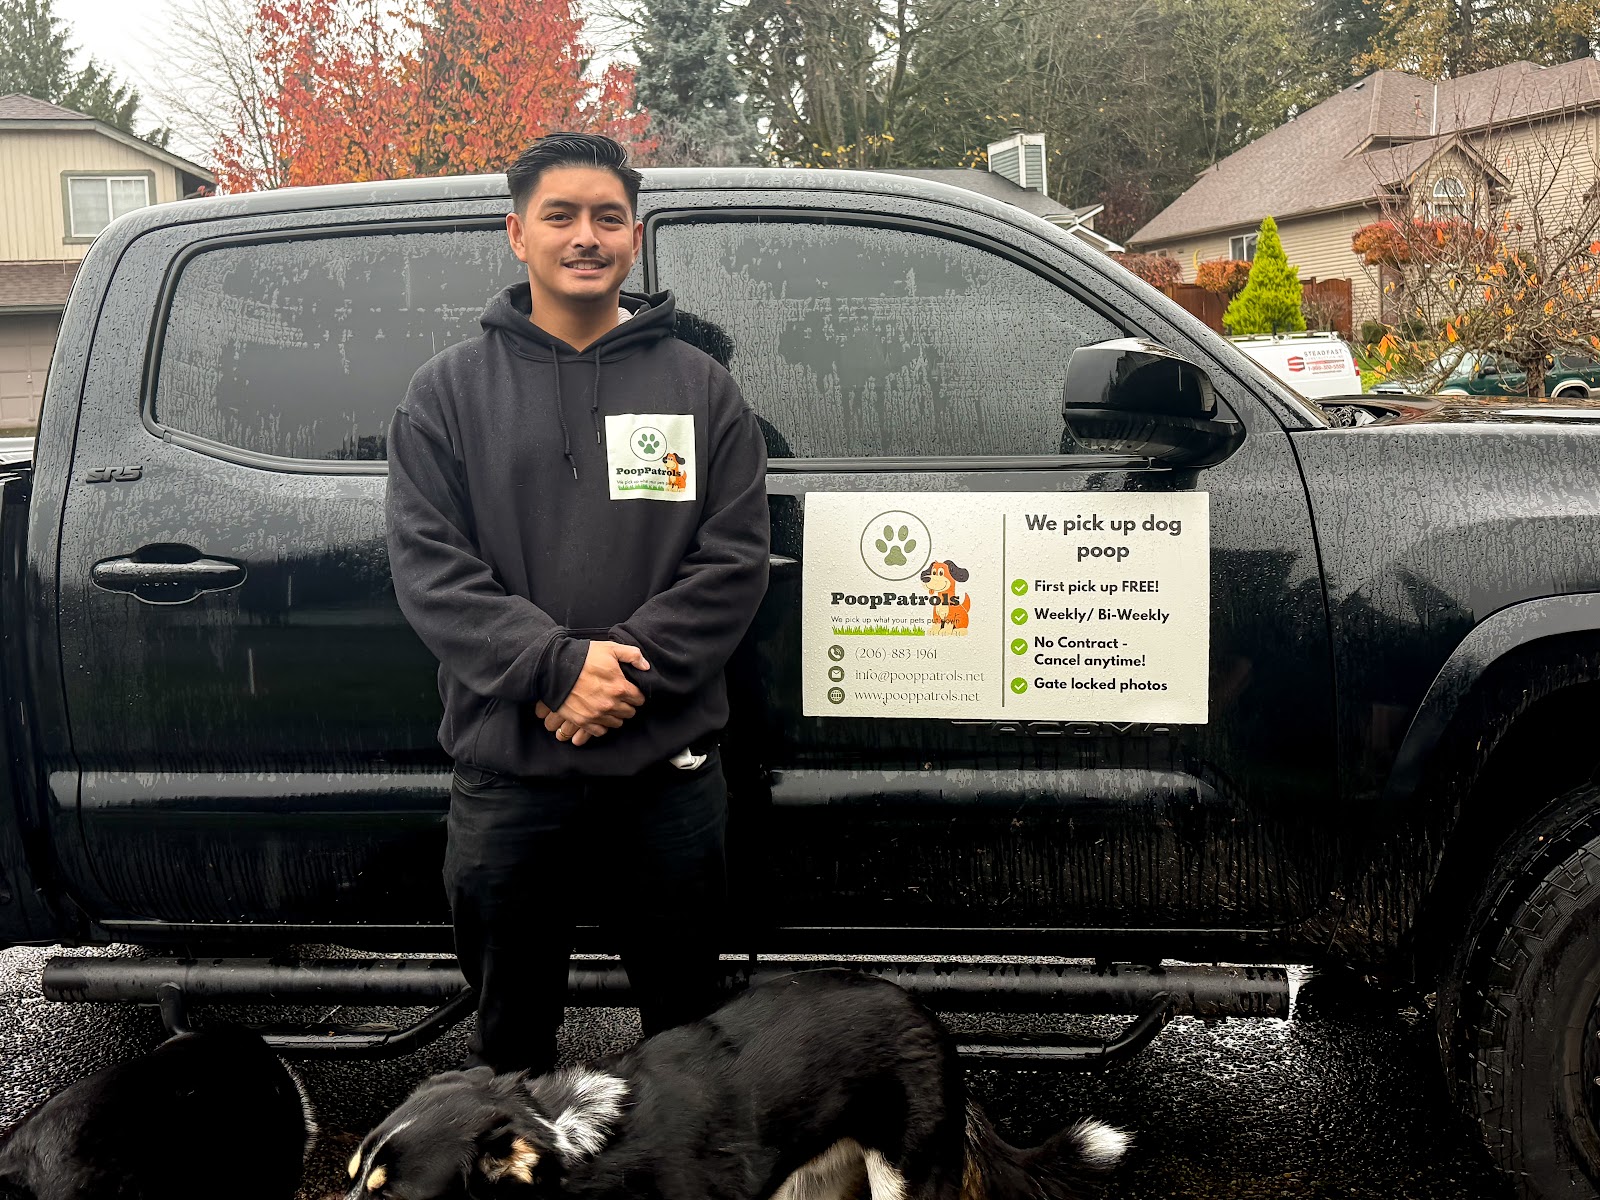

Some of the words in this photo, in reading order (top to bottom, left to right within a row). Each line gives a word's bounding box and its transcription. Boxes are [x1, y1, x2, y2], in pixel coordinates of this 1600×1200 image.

[1304, 349, 1342, 357] STEADFAST
[86, 466, 143, 483] SR5
[616, 467, 681, 476] PoopPatrols
[1025, 514, 1057, 530] We
[1063, 514, 1104, 535] pick
[1110, 519, 1136, 535] up
[1142, 514, 1182, 536] dog
[1077, 546, 1129, 562] poop
[1034, 580, 1065, 592] First
[1068, 580, 1096, 595] pick
[1100, 583, 1118, 595] up
[1122, 581, 1159, 592] FREE!
[831, 592, 960, 609] PoopPatrols
[845, 616, 859, 624] pick
[1034, 608, 1094, 623] Weekly/
[1098, 608, 1170, 624] Bi-Weekly
[1034, 637, 1054, 648] No
[1057, 637, 1119, 648] Contract
[1034, 654, 1080, 666] Cancel
[1084, 655, 1146, 669] anytime!
[855, 669, 985, 683] info@pooppatrols.net
[1034, 678, 1067, 689] Gate
[1071, 678, 1116, 690] locked
[1119, 678, 1168, 693] photos
[854, 690, 979, 704] www.pooppatrols.net
